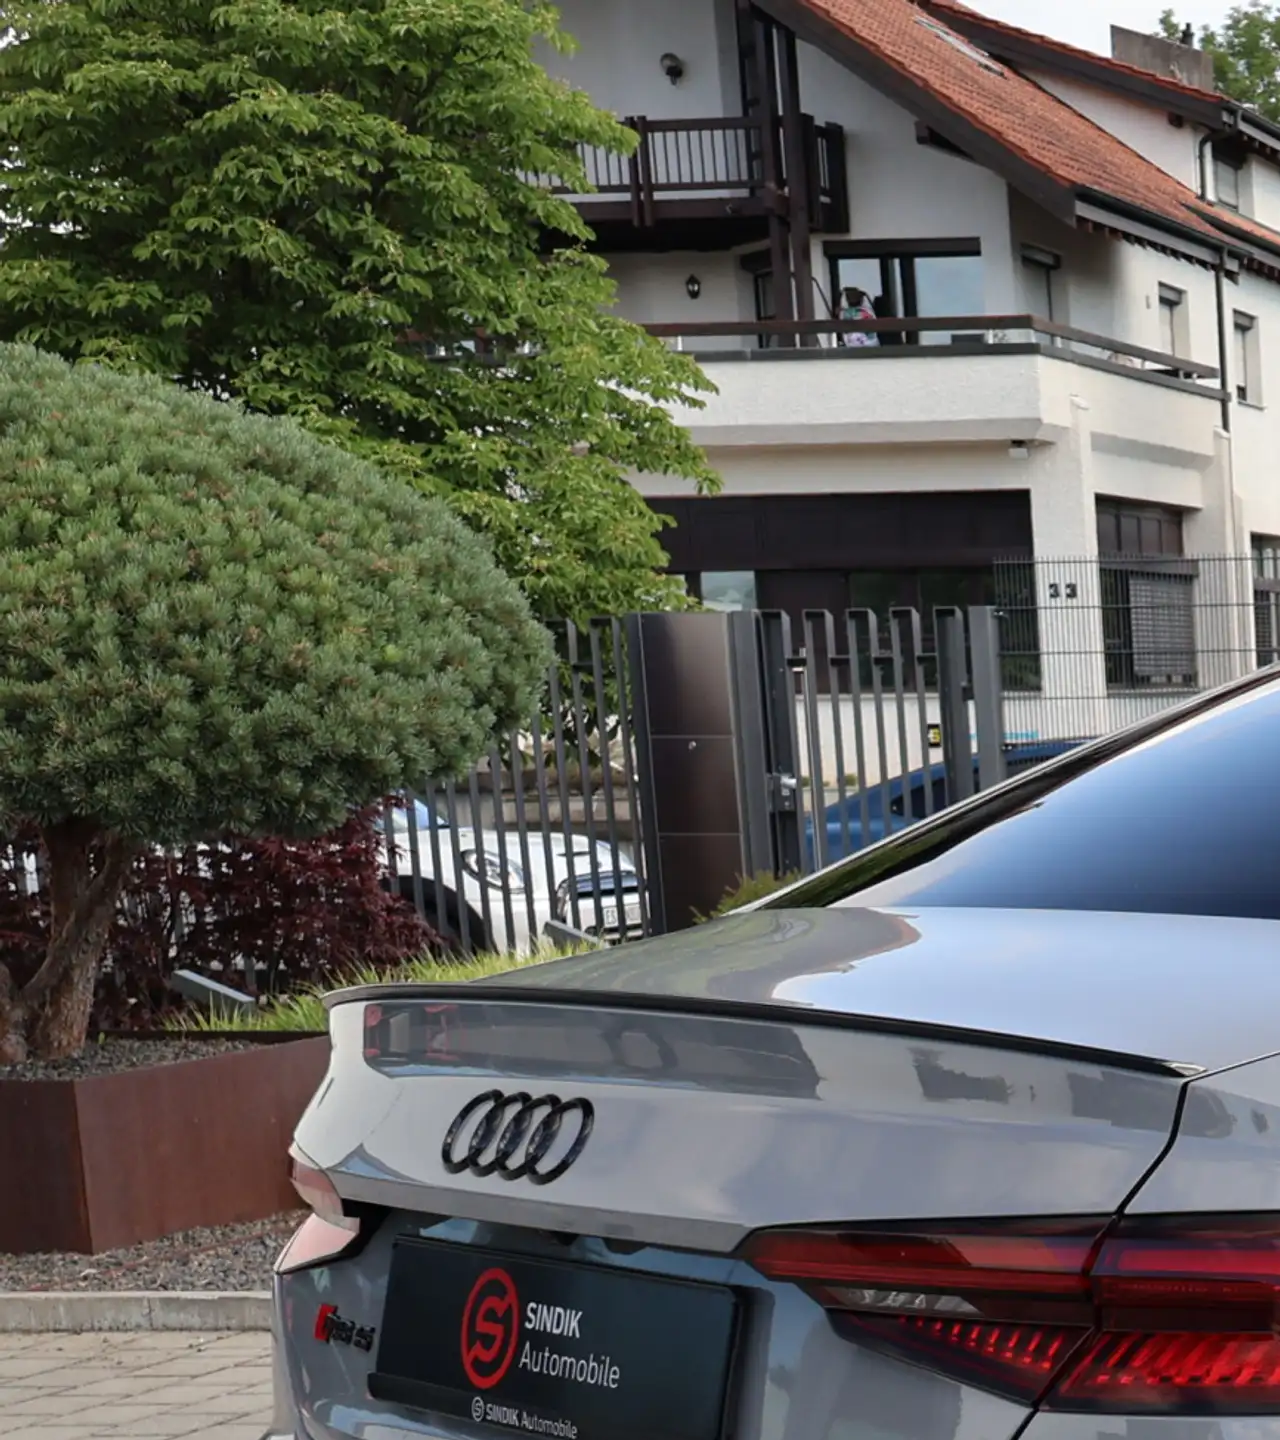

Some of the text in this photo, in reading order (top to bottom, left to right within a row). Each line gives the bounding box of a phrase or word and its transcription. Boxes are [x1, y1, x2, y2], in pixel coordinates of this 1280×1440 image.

[1049, 583, 1077, 598] 33
[524, 1301, 583, 1339] SINDIK
[519, 1340, 620, 1389] Automobile
[486, 1403, 519, 1427] SINDIK
[521, 1411, 578, 1439] Automobile
